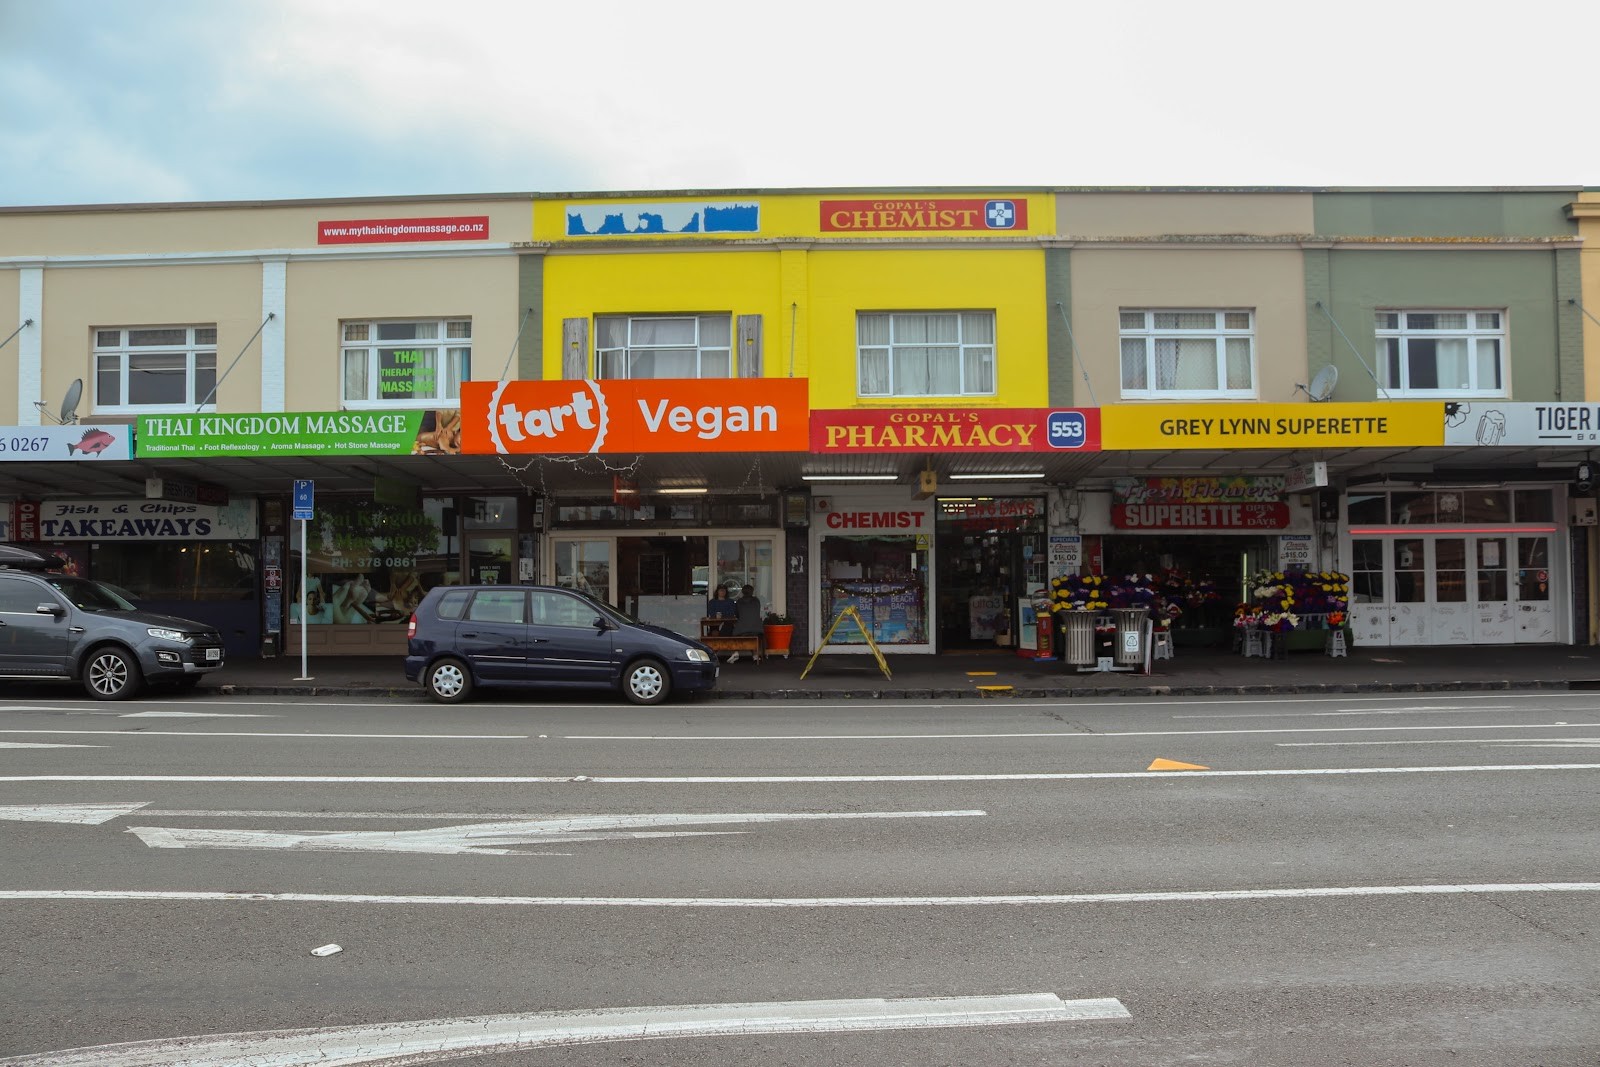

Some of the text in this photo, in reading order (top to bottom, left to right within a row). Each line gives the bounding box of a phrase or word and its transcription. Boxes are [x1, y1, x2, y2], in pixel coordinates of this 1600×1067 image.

[873, 201, 936, 210] GOPAL'S
[830, 210, 978, 228] CHEMIST
[323, 223, 484, 238] www.mythaikingdommassage.co.nz
[381, 368, 434, 377] THERAPE
[498, 391, 597, 442] tart
[637, 399, 778, 440] Vegan
[890, 412, 979, 423] GOPAL'S
[1535, 407, 1591, 430] TIGER
[145, 415, 407, 437] THAI KINGDOM MASSAGE
[1160, 417, 1388, 436] GREY LYNN SUPERETTE
[825, 421, 1083, 448] PHARMACY 553
[11, 437, 49, 452] 0267
[221, 443, 260, 452] Reflexology
[294, 442, 325, 451] Massage
[349, 441, 369, 449] Stone
[370, 441, 401, 451] Massage
[300, 481, 308, 490] P
[1125, 482, 1278, 498] Fresh Flowers
[56, 503, 197, 516] Fish & Chips
[475, 502, 505, 523] 557
[946, 502, 985, 516] OEN
[999, 501, 1035, 516] DAYS
[1125, 504, 1243, 527] SUPERETTE
[1245, 504, 1275, 512] OPEN
[20, 503, 35, 539] OPEN
[41, 518, 211, 537] TAKEAWAYS
[826, 512, 925, 529] CHEMIST
[336, 532, 417, 552] Masage
[357, 558, 381, 567] 378
[385, 557, 418, 567] 0861
[891, 595, 915, 603] BEACH
[891, 602, 905, 610] BAG
